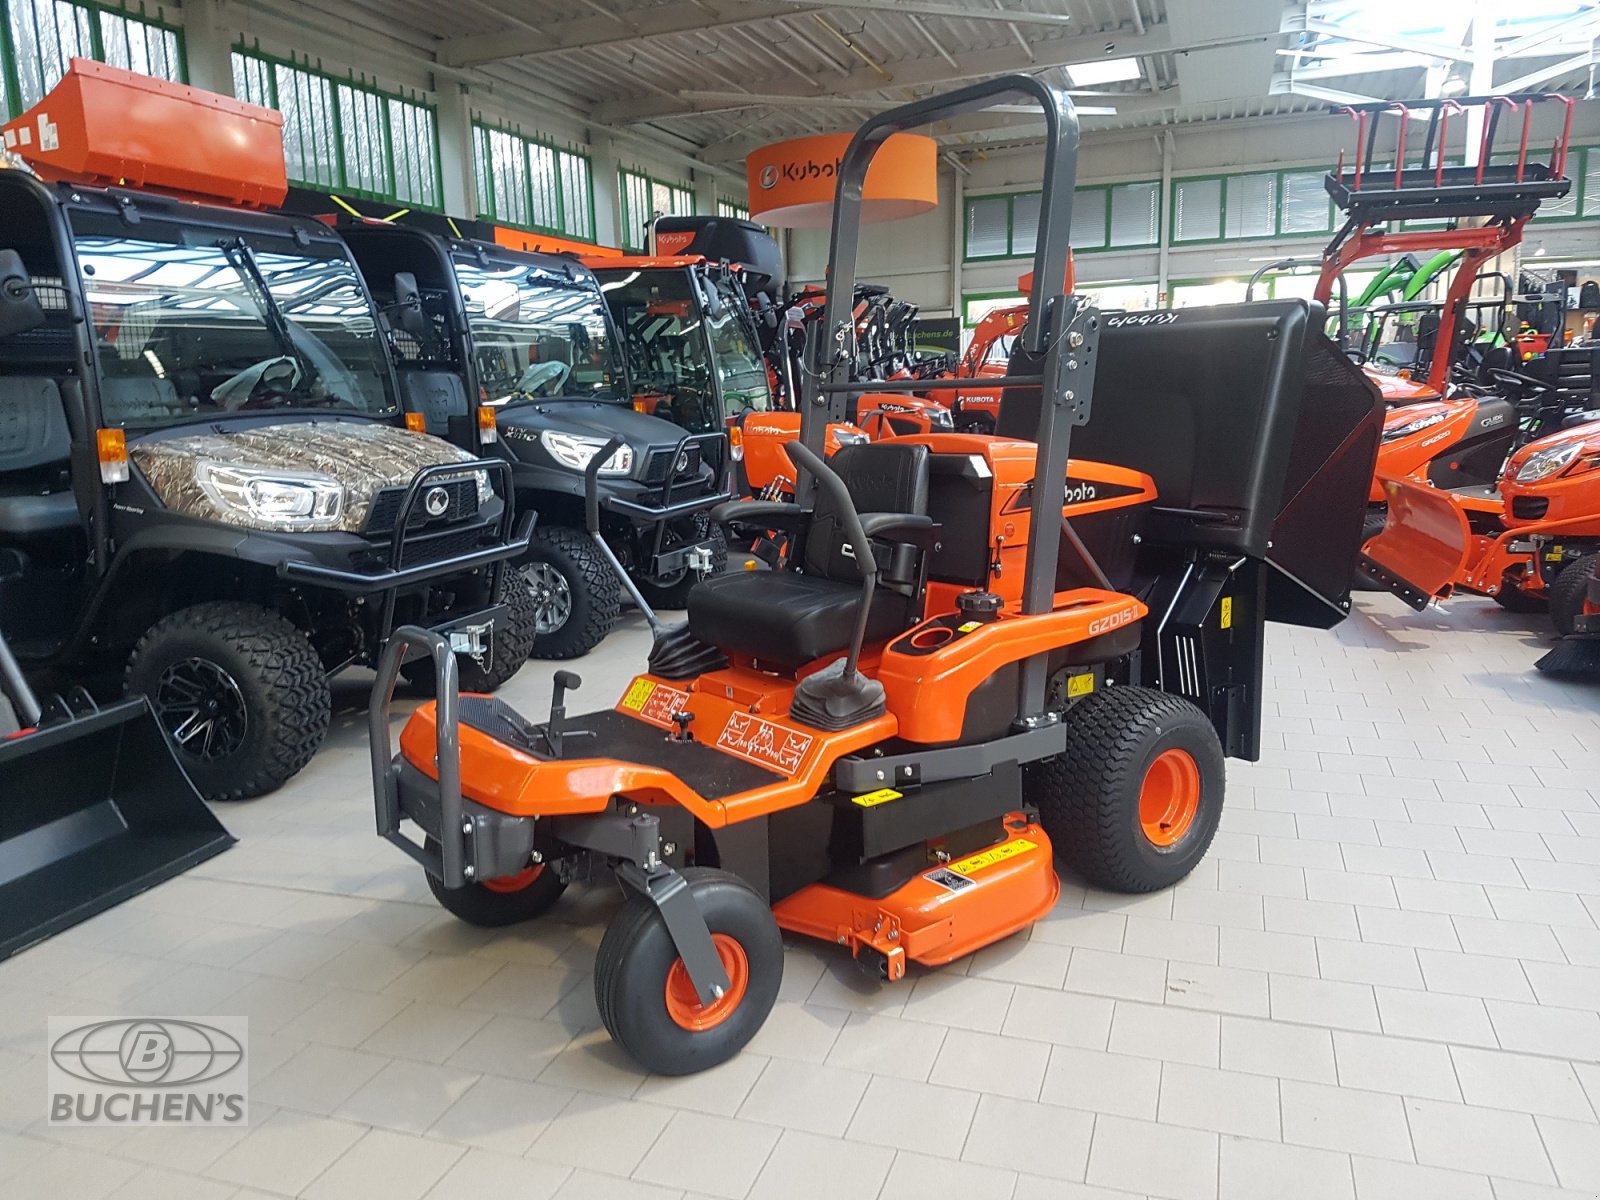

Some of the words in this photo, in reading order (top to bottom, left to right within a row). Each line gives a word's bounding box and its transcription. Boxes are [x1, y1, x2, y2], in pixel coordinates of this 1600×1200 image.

[783, 157, 841, 181] Kubot
[1107, 312, 1180, 328] Kubota
[1064, 482, 1096, 502] bota
